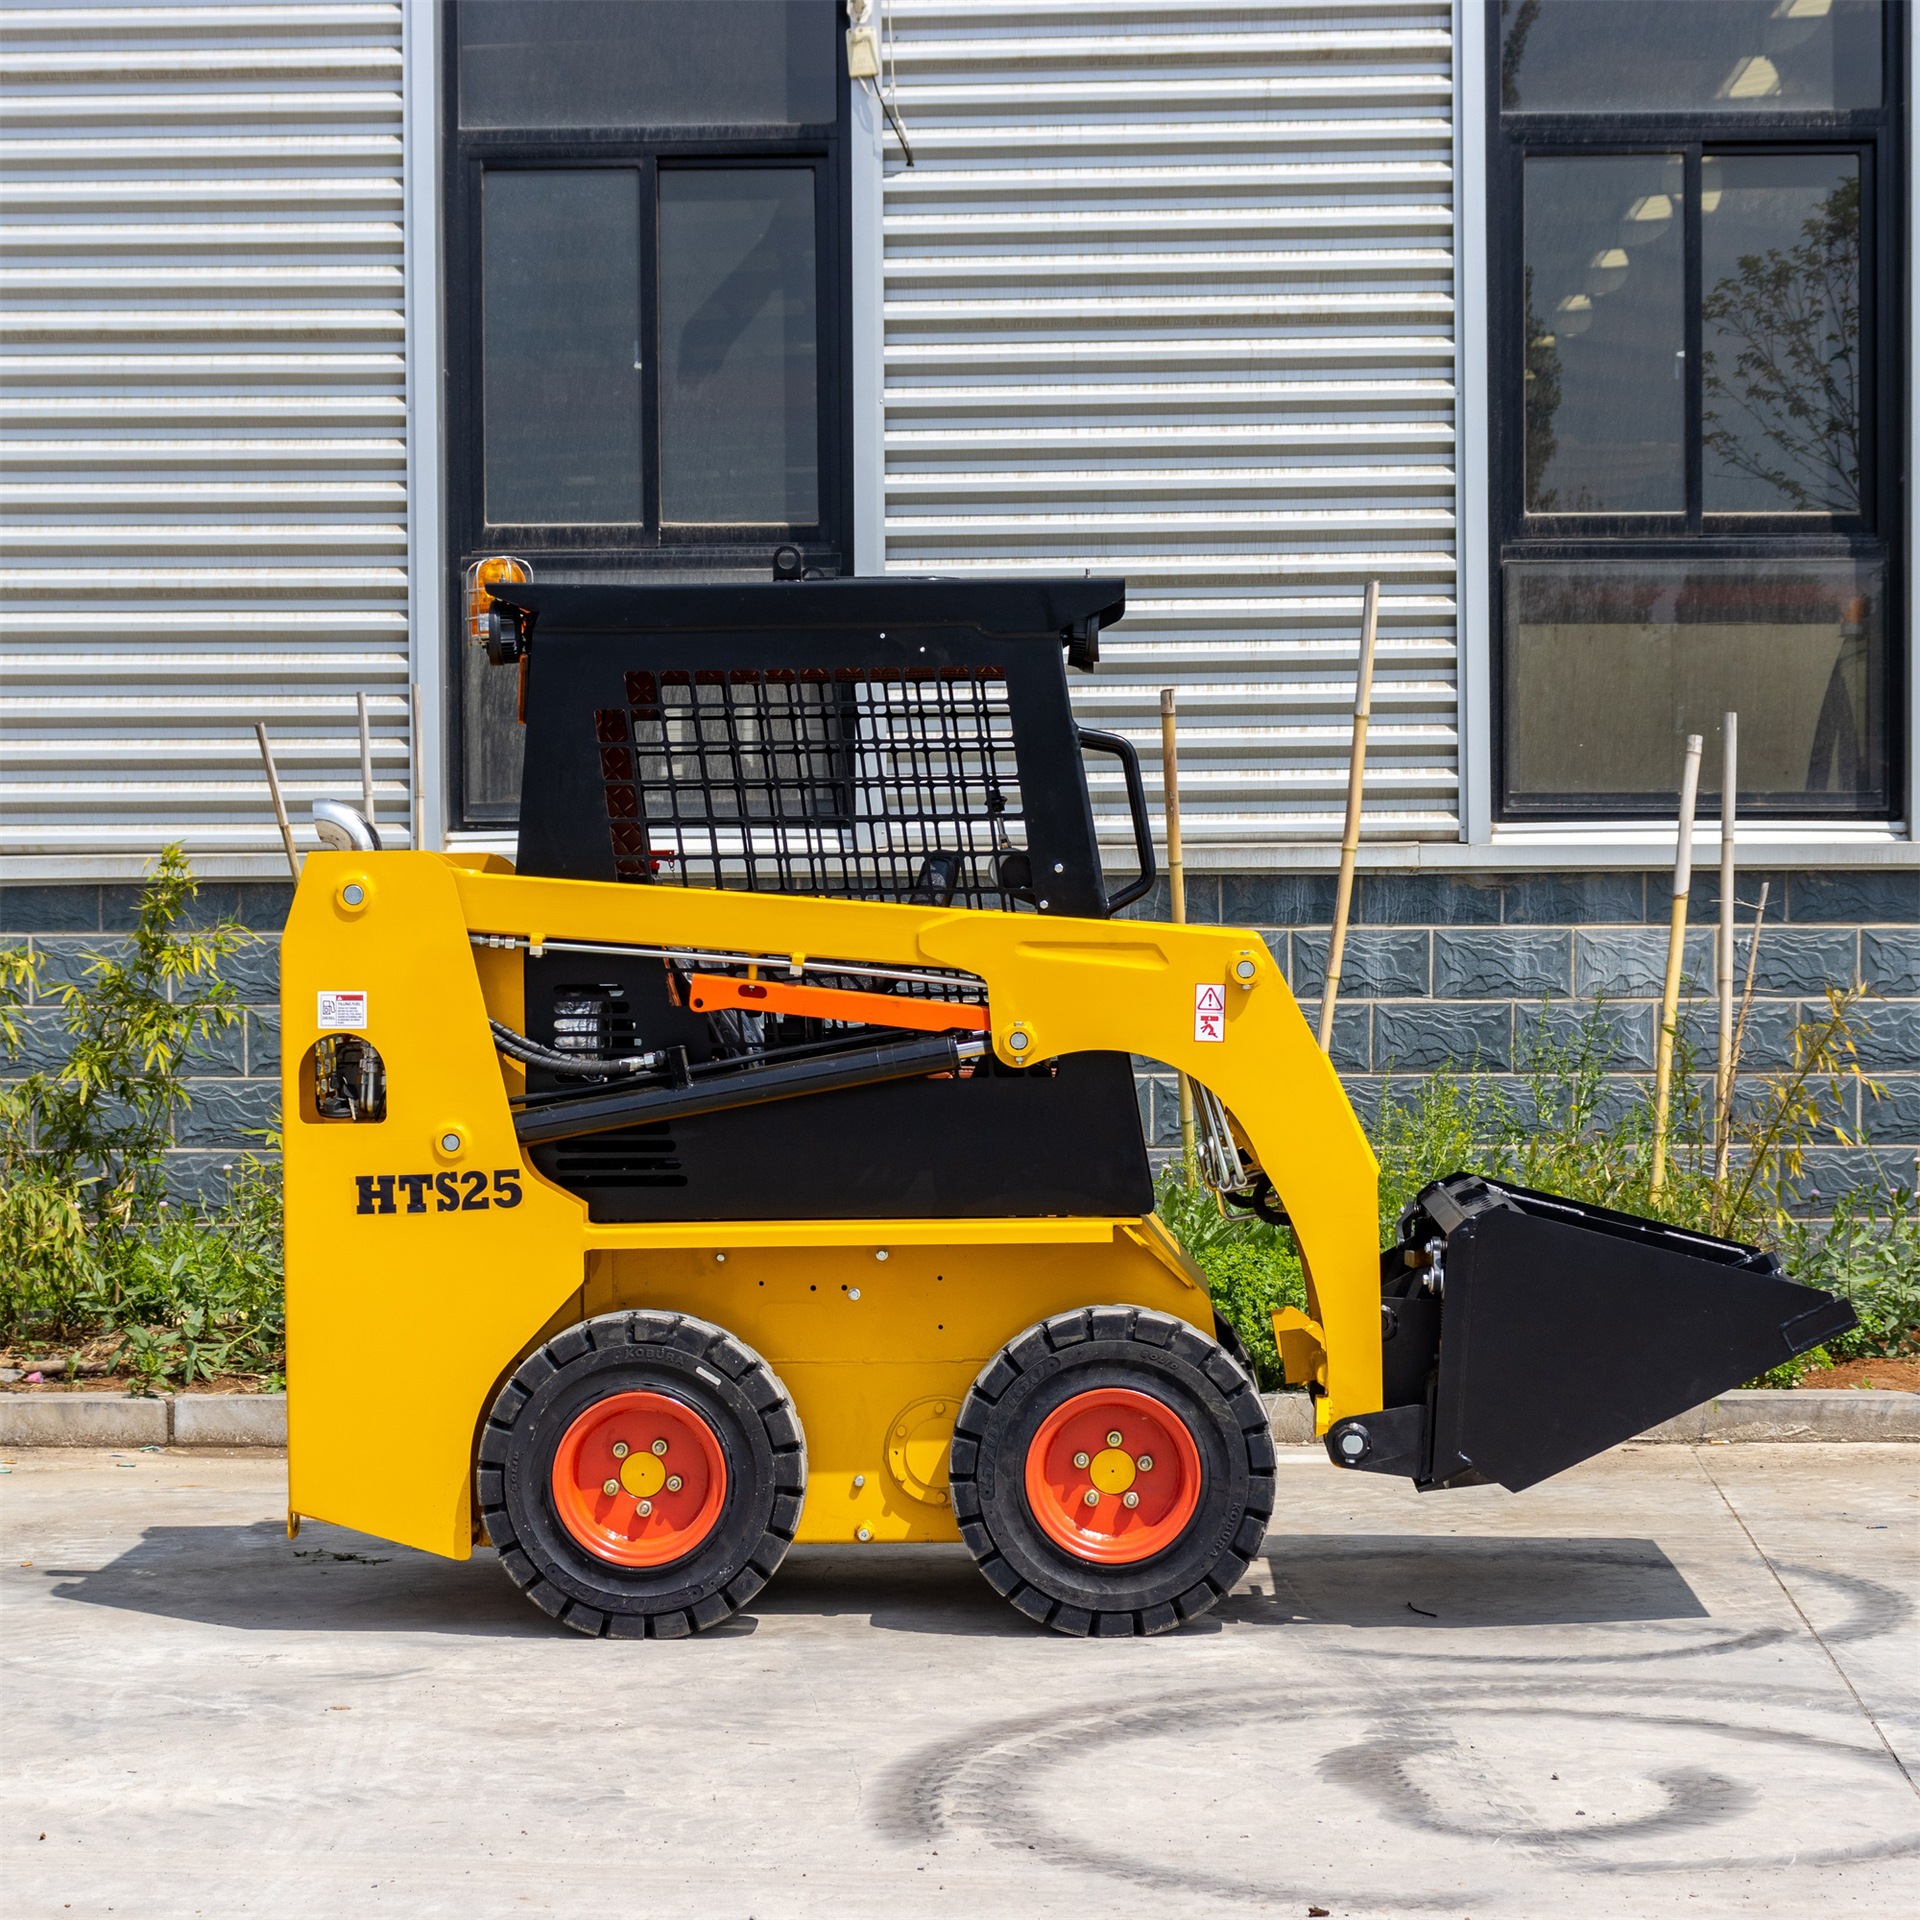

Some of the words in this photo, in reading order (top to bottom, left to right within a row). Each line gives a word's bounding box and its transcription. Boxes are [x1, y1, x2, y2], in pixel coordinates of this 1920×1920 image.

[355, 1169, 523, 1215] HTS25
[624, 1347, 686, 1366] KOBURA
[1139, 1350, 1179, 1370] SOLID
[1210, 1502, 1243, 1559] KOBURA
